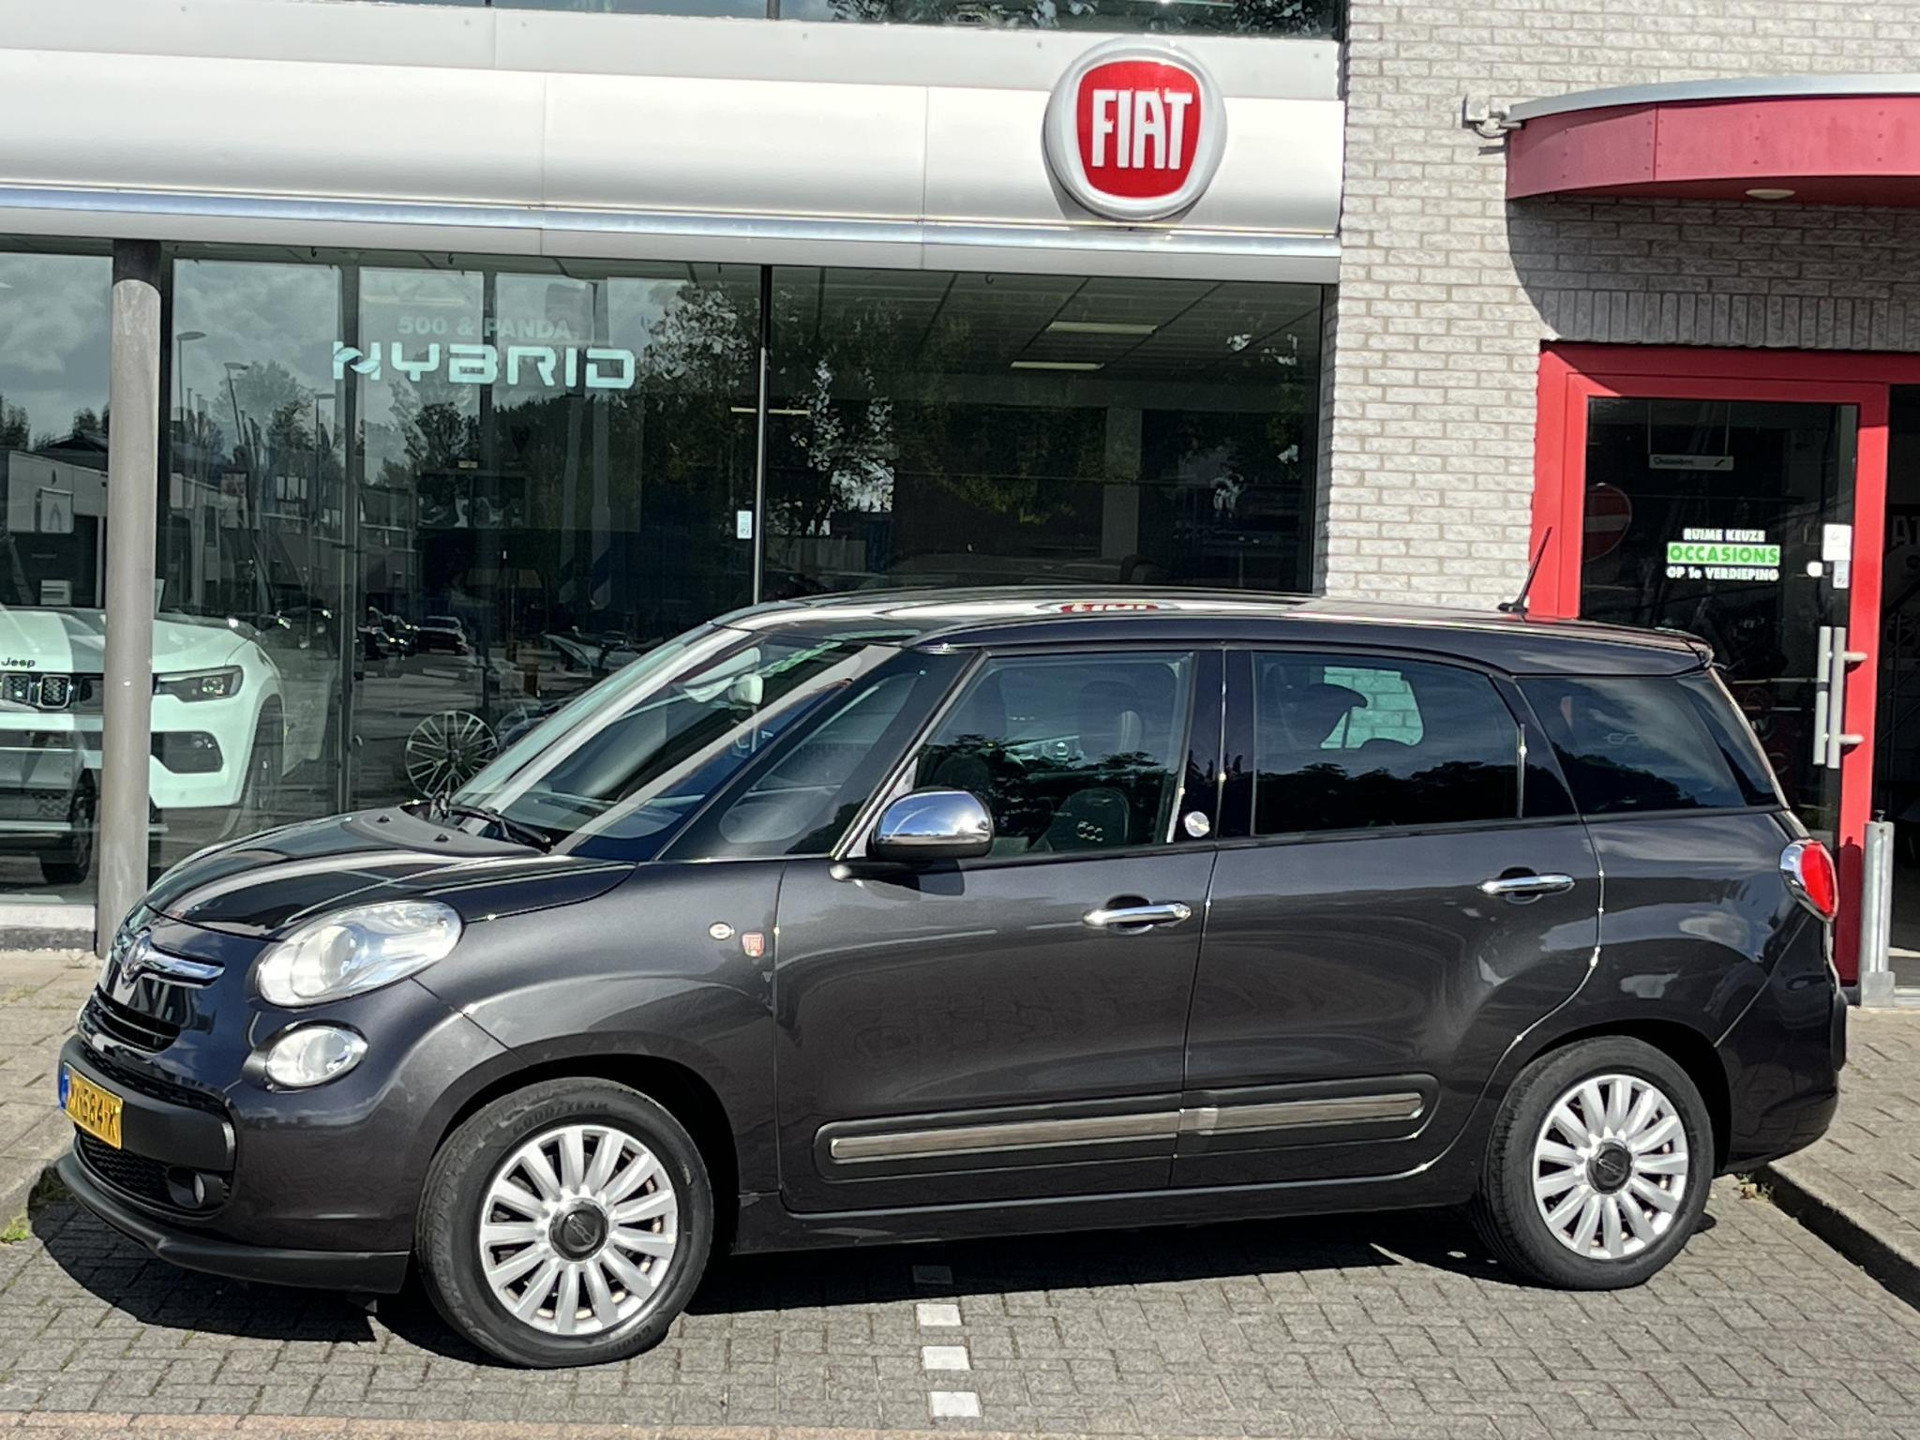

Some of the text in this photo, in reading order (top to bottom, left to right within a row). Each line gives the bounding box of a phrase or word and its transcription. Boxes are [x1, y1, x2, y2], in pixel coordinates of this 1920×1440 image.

[1091, 88, 1194, 170] FIAT
[399, 315, 572, 339] 500 & PANDA
[332, 341, 636, 390] HYBRID
[1683, 528, 1766, 543] RUIME KEUZE
[1669, 545, 1779, 564] OCCASIONS
[1666, 566, 1780, 582] OP 1e VERDIEPING
[1, 657, 36, 669] Jeep
